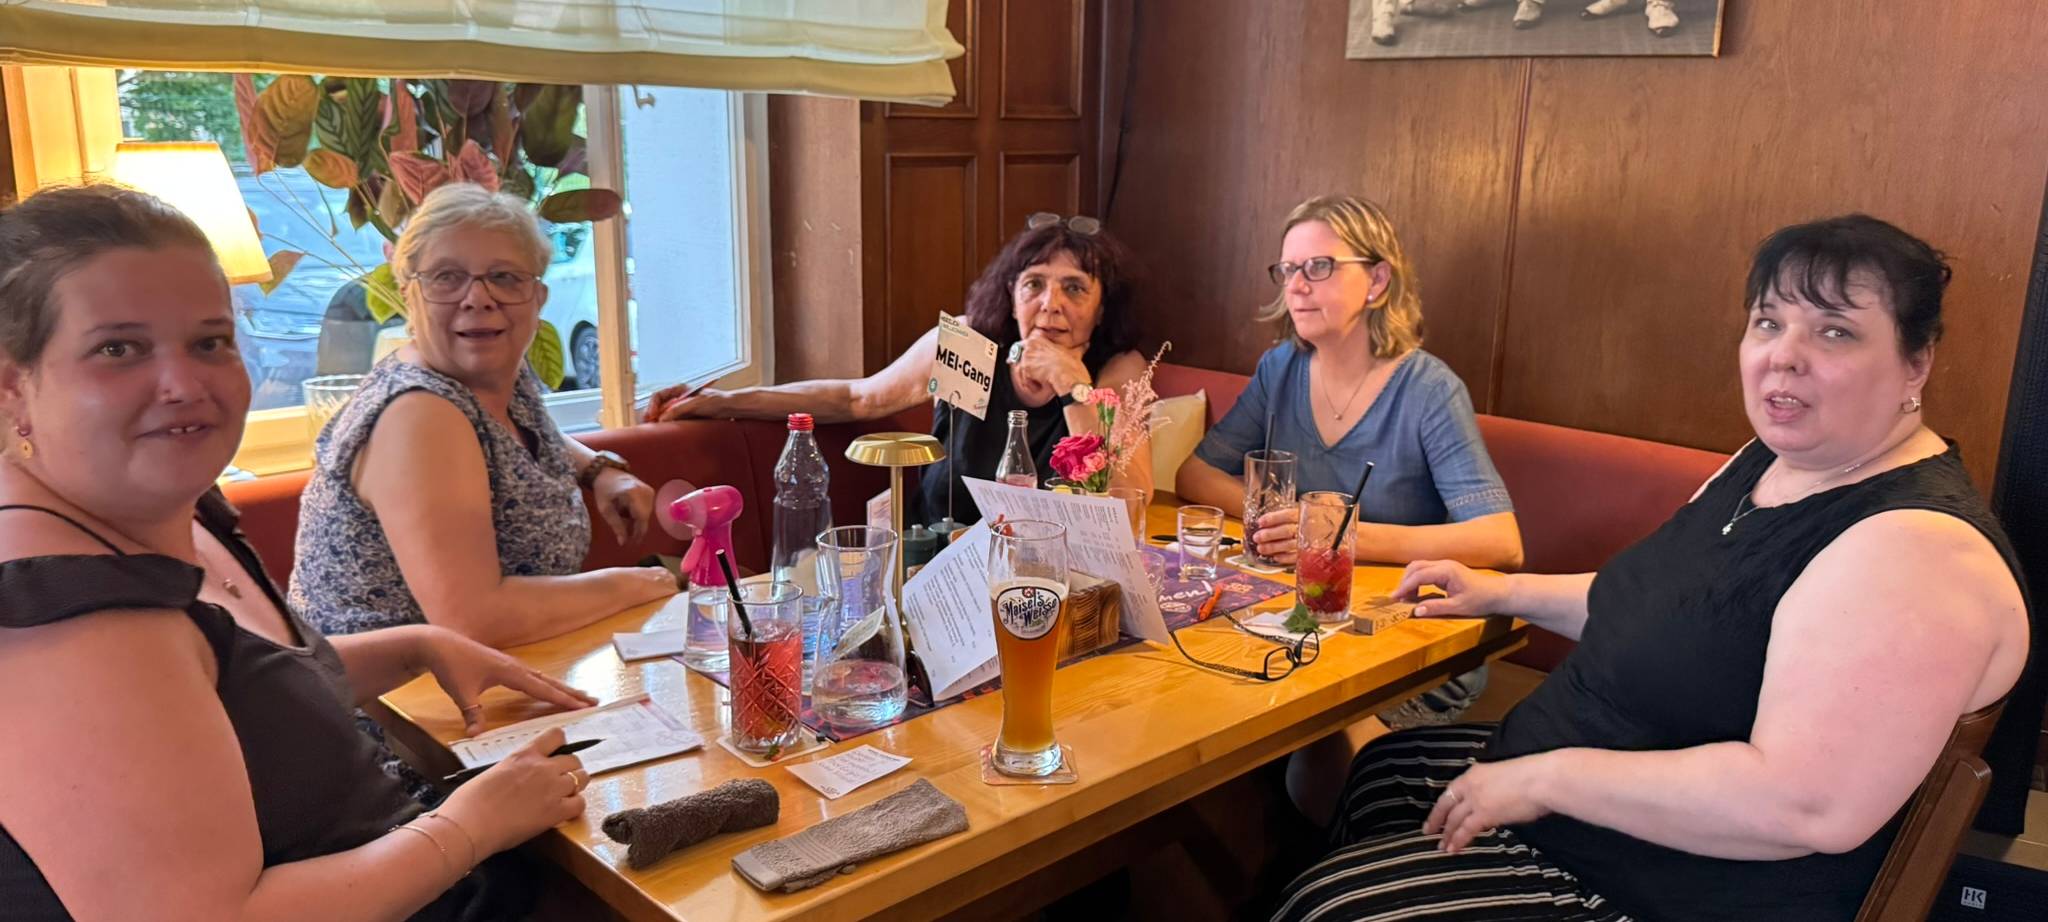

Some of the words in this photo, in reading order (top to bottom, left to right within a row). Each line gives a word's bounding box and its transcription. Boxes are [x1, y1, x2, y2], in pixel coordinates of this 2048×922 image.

[936, 345, 991, 391] MEI-Gang
[1002, 590, 1045, 624] Maisel's
[1964, 888, 1984, 903] HK
